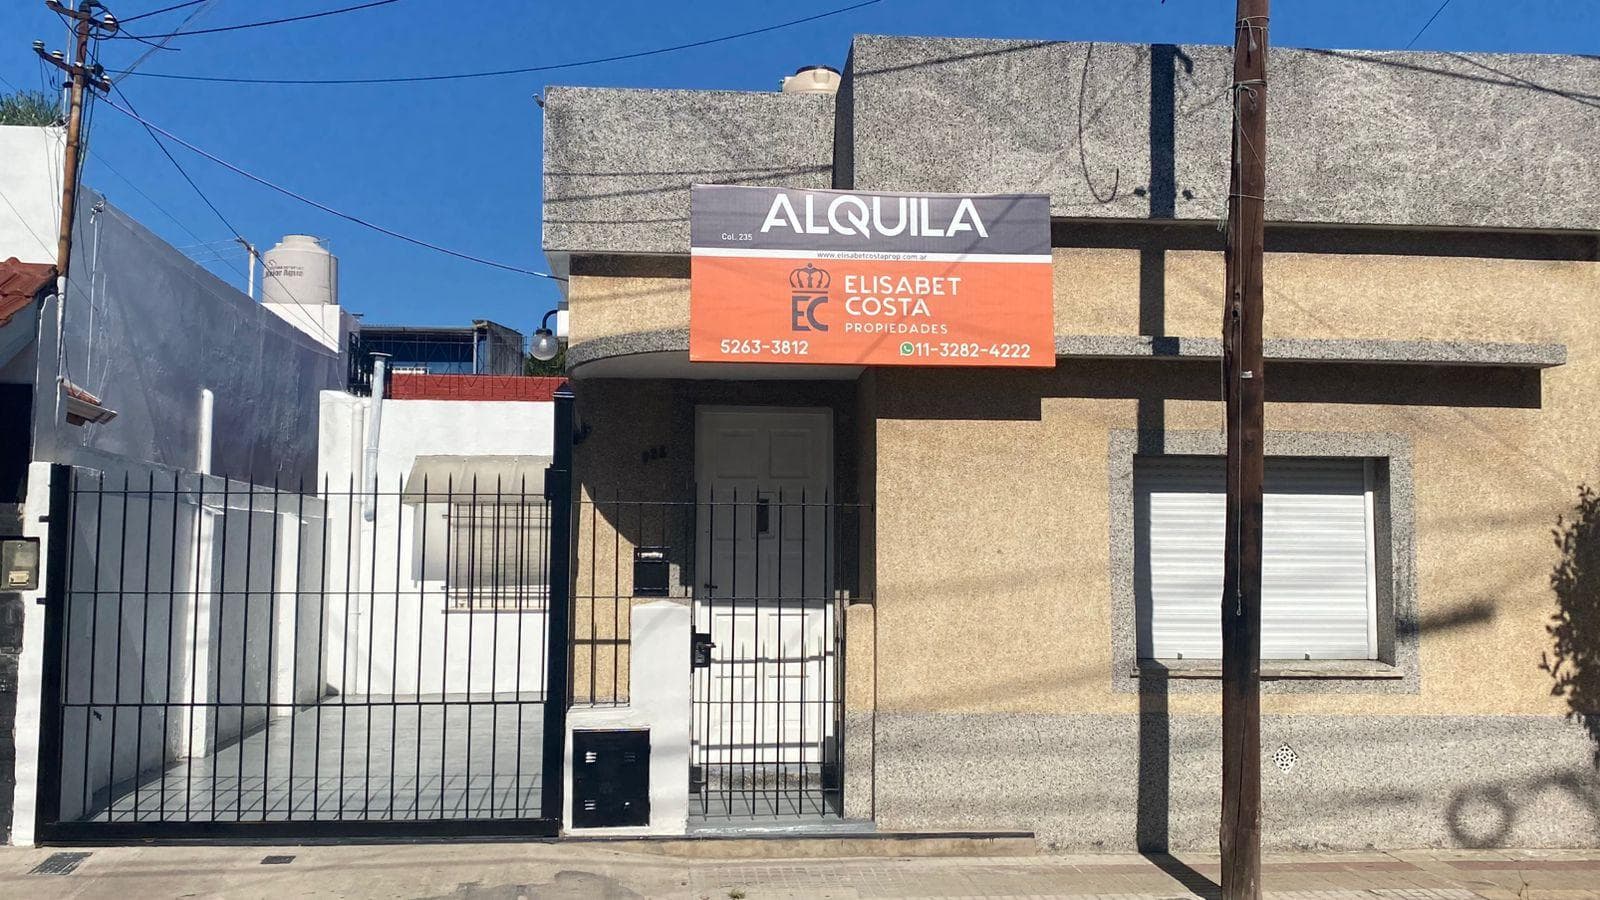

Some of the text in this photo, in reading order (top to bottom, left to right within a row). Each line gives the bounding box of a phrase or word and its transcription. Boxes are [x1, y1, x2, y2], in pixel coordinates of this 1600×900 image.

[760, 193, 989, 239] ALQUILA
[721, 232, 753, 241] Col. 235
[816, 251, 928, 262] www.elisabetcostaprop.com.ar
[844, 275, 962, 297] ELISABET
[791, 296, 829, 332] EC
[845, 297, 931, 317] COSTA
[845, 322, 949, 336] PROPIEDADES
[720, 339, 809, 356] 5263-3812
[915, 342, 1031, 359] 11-3282-4222
